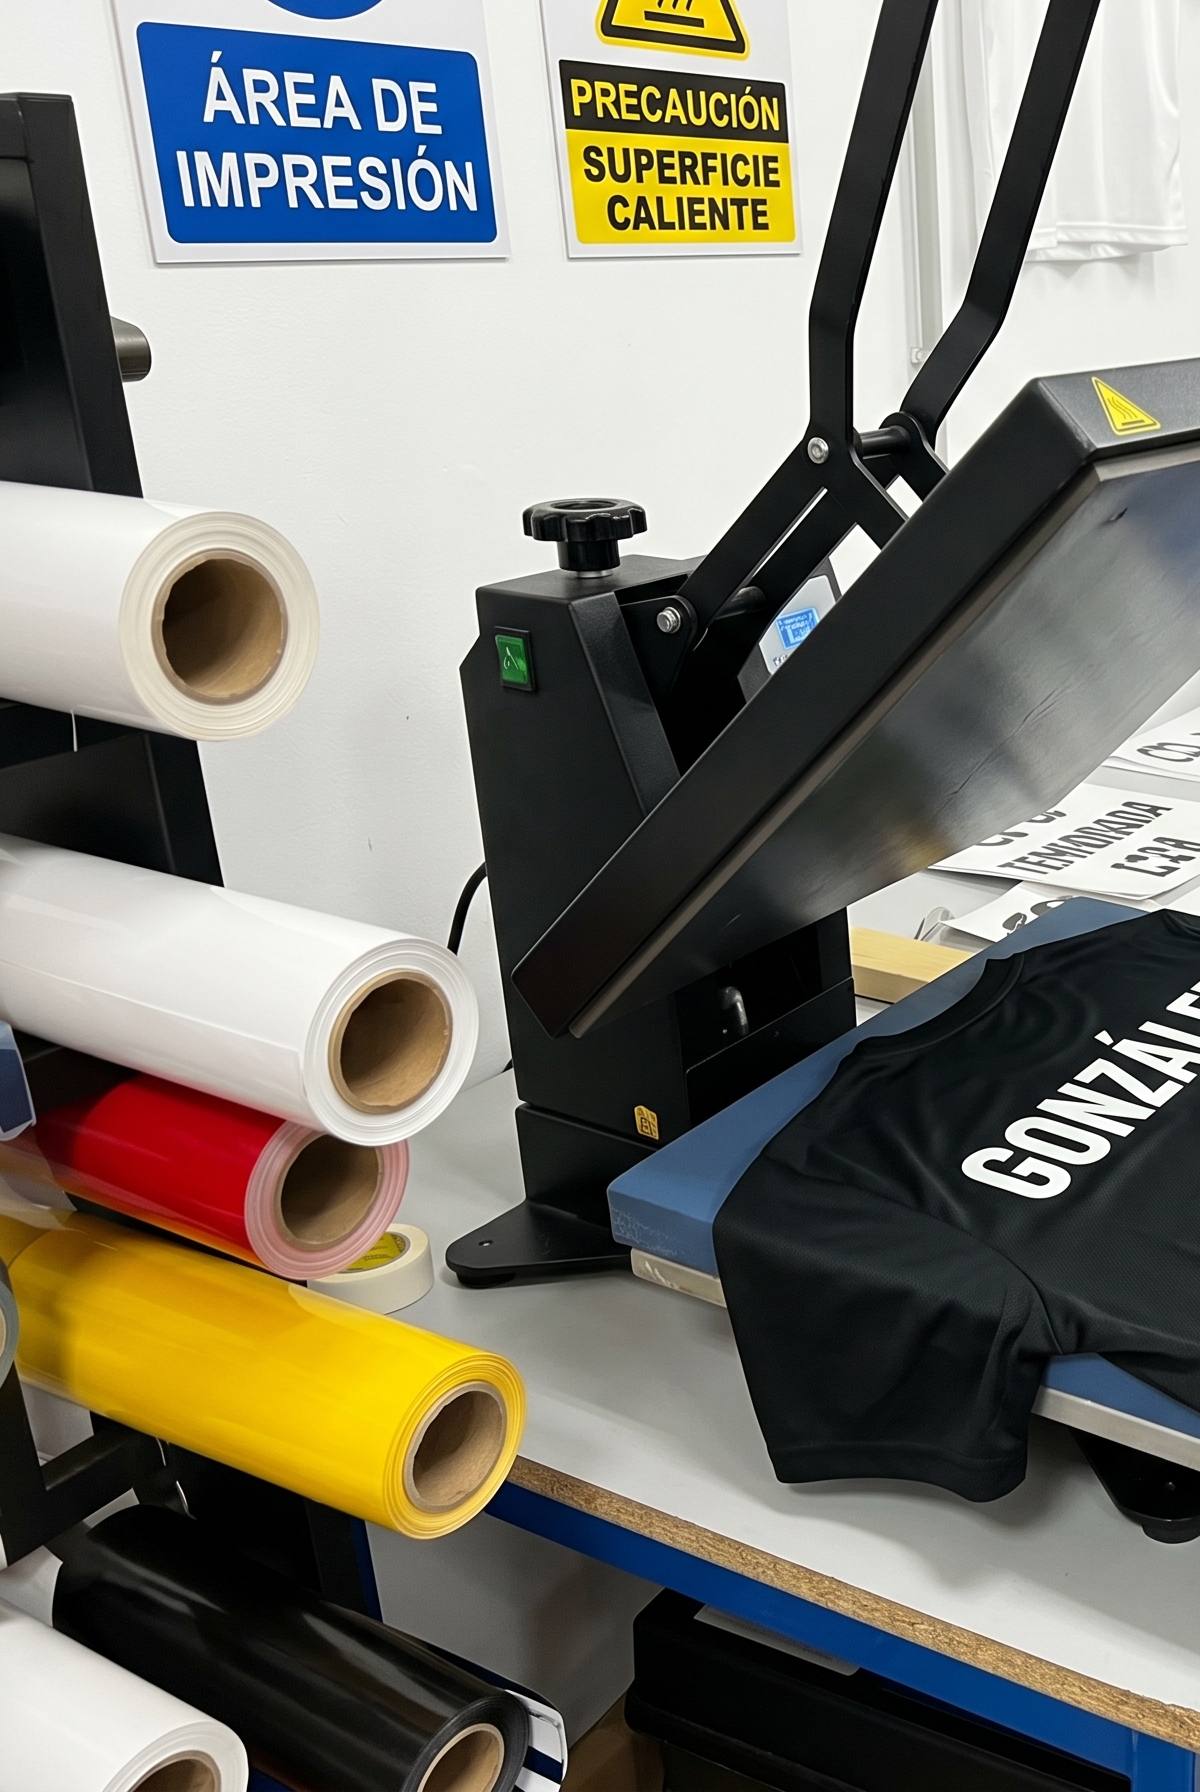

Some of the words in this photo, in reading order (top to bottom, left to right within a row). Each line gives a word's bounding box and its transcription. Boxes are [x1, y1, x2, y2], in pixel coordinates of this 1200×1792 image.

[203, 50, 362, 131] ÁREA
[372, 78, 443, 135] DE
[571, 78, 781, 131] PRECAUCIÓN
[176, 145, 479, 212] IMPRESIÓN
[583, 145, 781, 188] SUPERFICIE
[607, 194, 770, 231] CALIENTE
